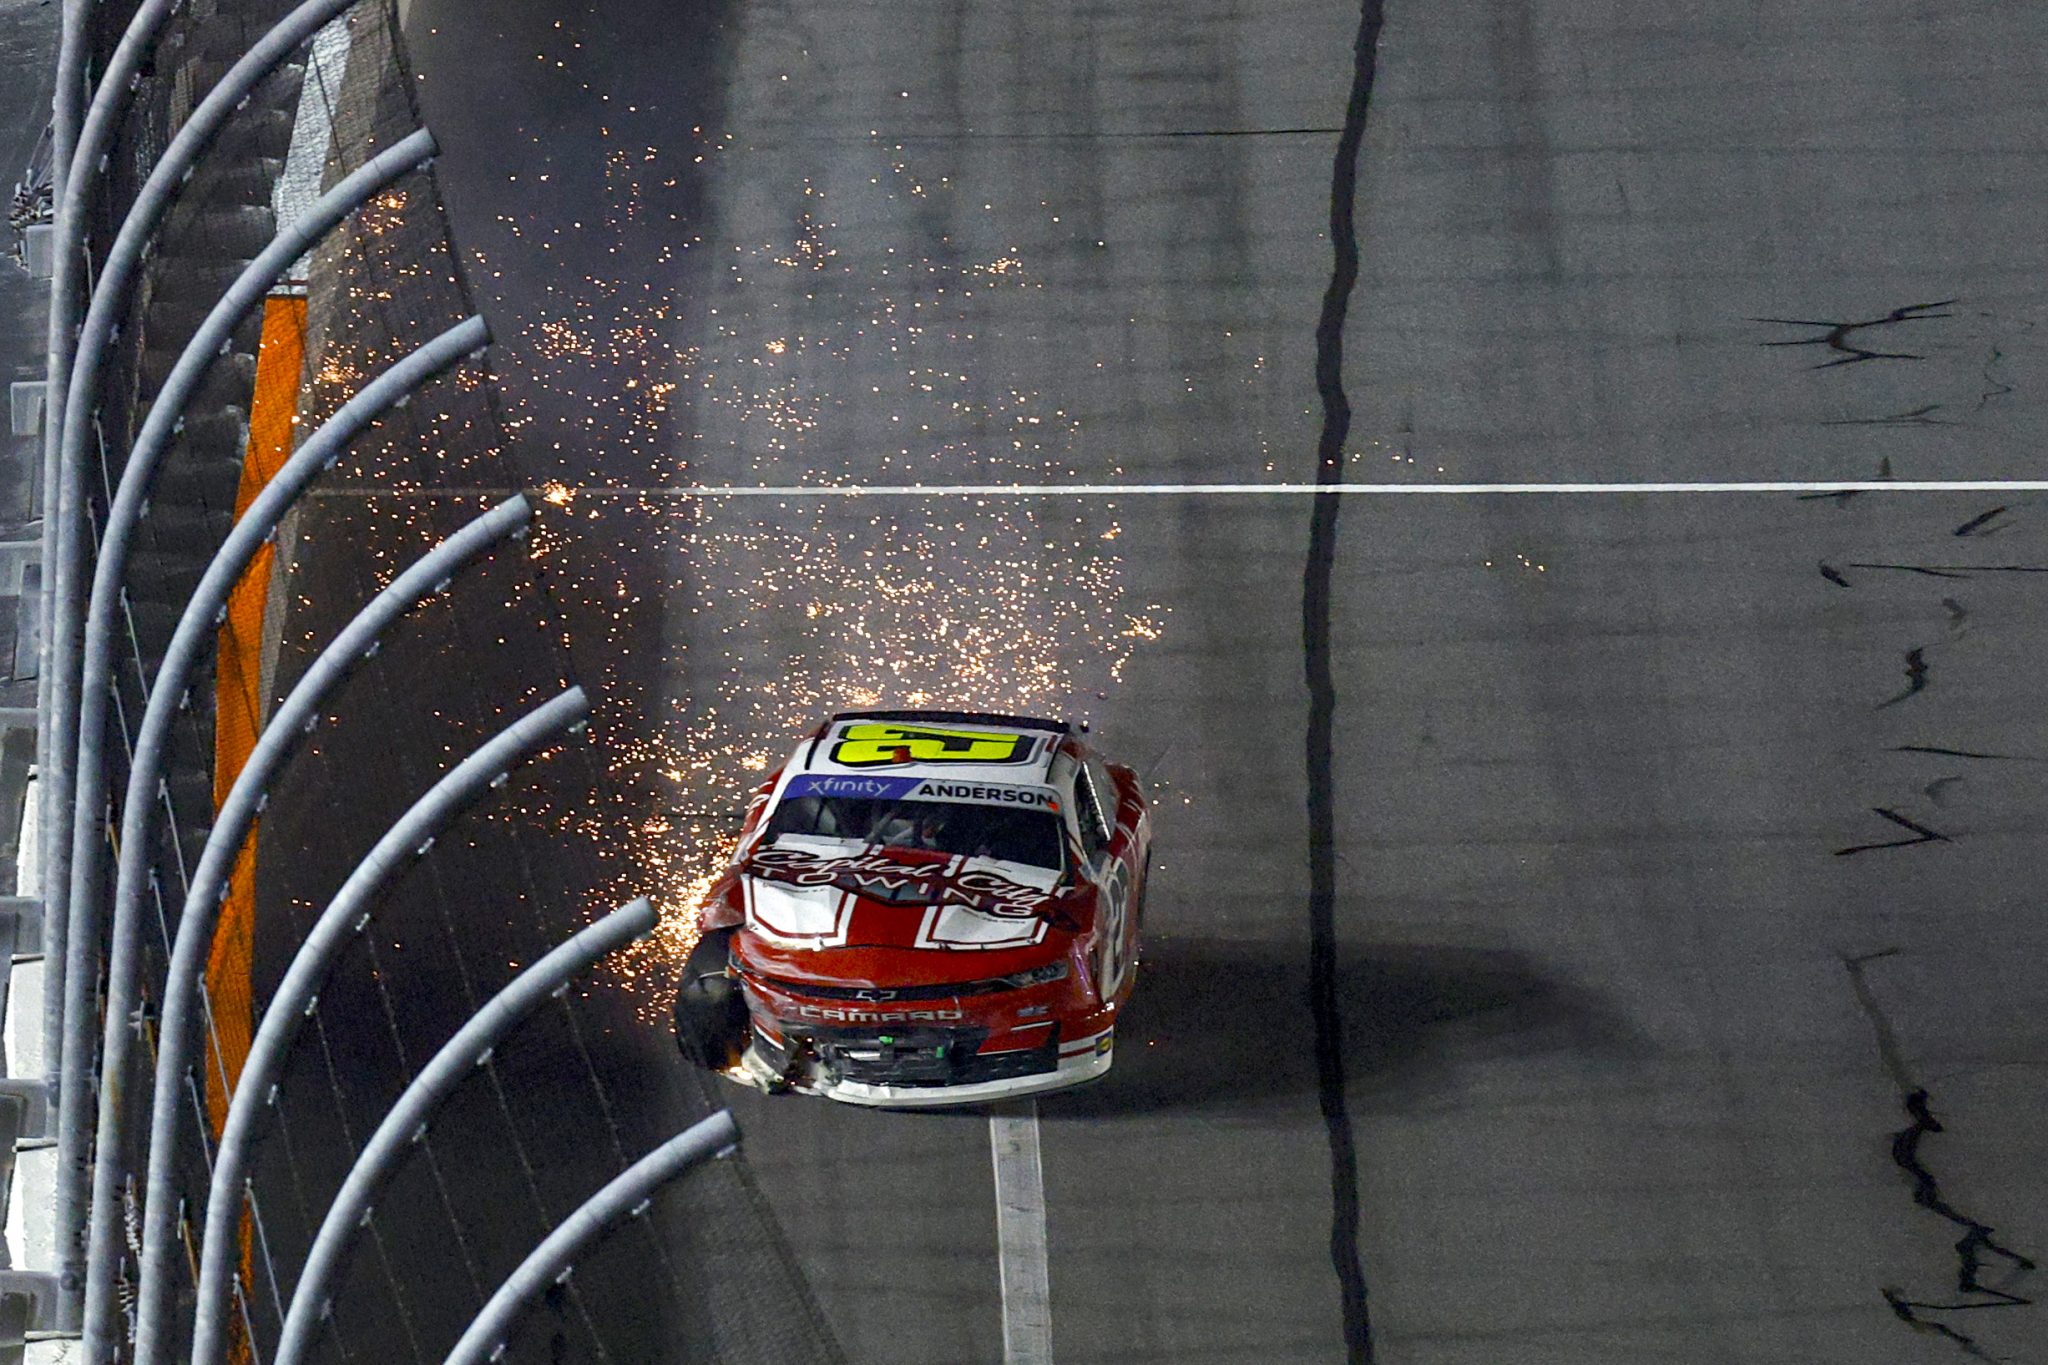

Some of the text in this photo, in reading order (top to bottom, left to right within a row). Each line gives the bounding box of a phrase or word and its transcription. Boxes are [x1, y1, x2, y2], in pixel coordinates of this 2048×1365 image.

[807, 777, 1054, 806] xfinity ANDERSON
[752, 851, 1052, 906] Capital City
[752, 864, 1034, 917] TOWING
[799, 1004, 963, 1022] CAMARO
